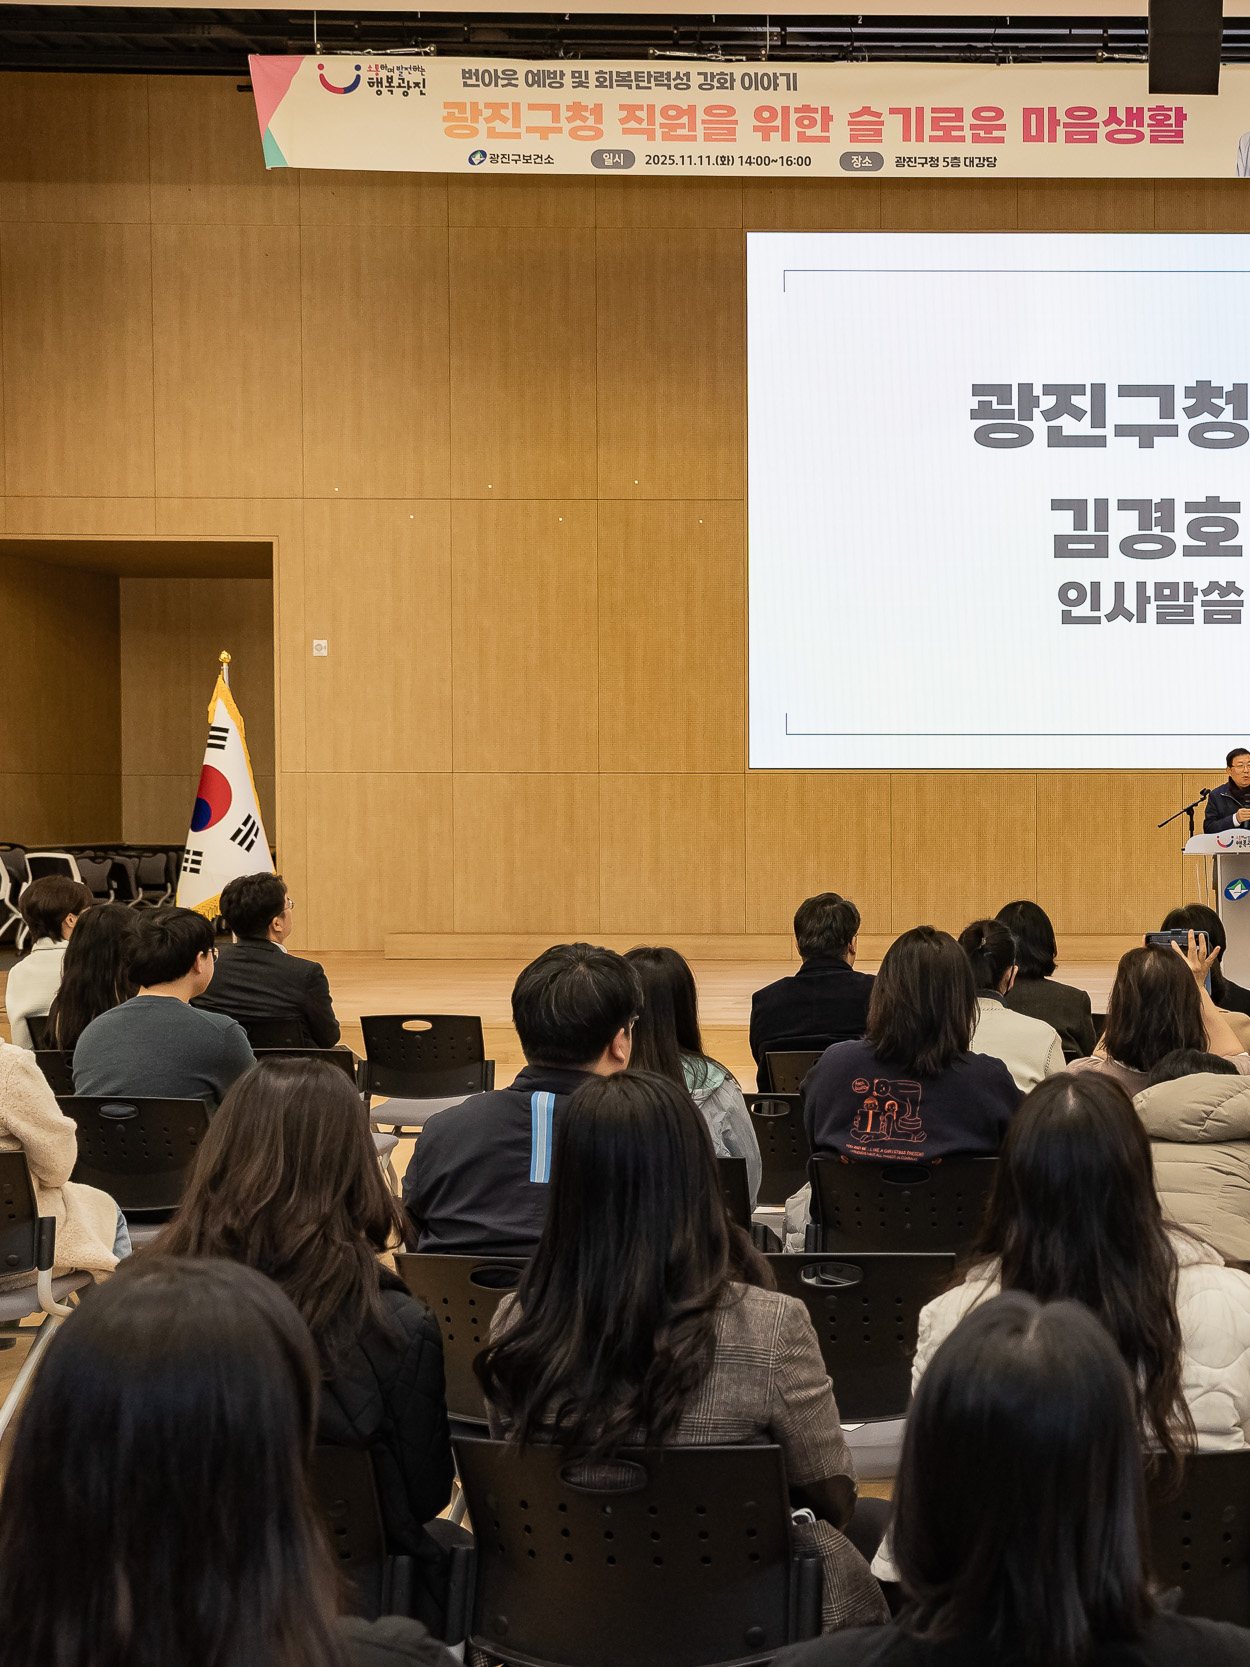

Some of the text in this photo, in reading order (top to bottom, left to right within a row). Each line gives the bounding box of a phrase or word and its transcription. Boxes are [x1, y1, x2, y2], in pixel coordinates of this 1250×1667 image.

[367, 64, 426, 77] 소통하며 발전하는
[461, 68, 798, 92] 번아웃 예방 및 회복탄력성 강화 이야기
[367, 75, 426, 97] 행복광진
[441, 100, 1188, 145] 광진구청 직원을 위한 슬기로운 마음생활
[489, 153, 555, 165] 광진구보건소
[603, 153, 812, 167] 일시 2025.11.11.(화) 14:00~16:00
[852, 155, 997, 168] 장소 광진구청 5층 대강당
[1050, 495, 1243, 561] 김경호
[1057, 580, 1245, 625] 인사말씀
